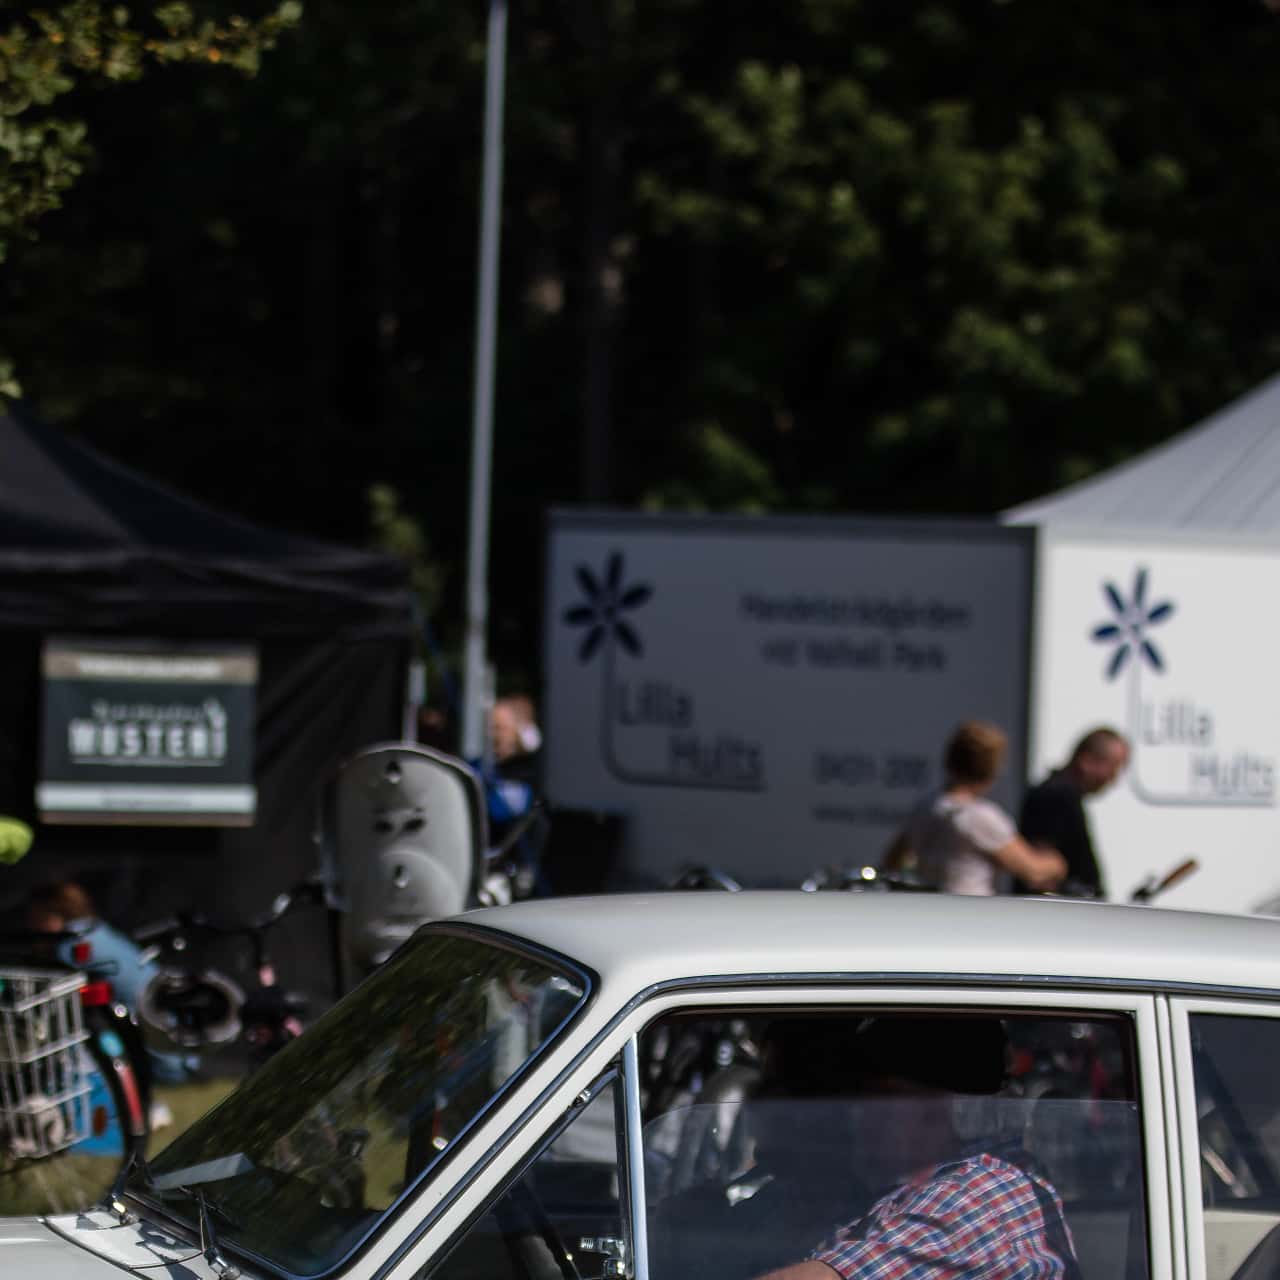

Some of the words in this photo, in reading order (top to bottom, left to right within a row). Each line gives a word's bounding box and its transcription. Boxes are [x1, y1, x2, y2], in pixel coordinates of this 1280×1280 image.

[617, 679, 693, 727] Lilla
[1137, 697, 1213, 745] Lilla
[1192, 746, 1276, 798] Hults
